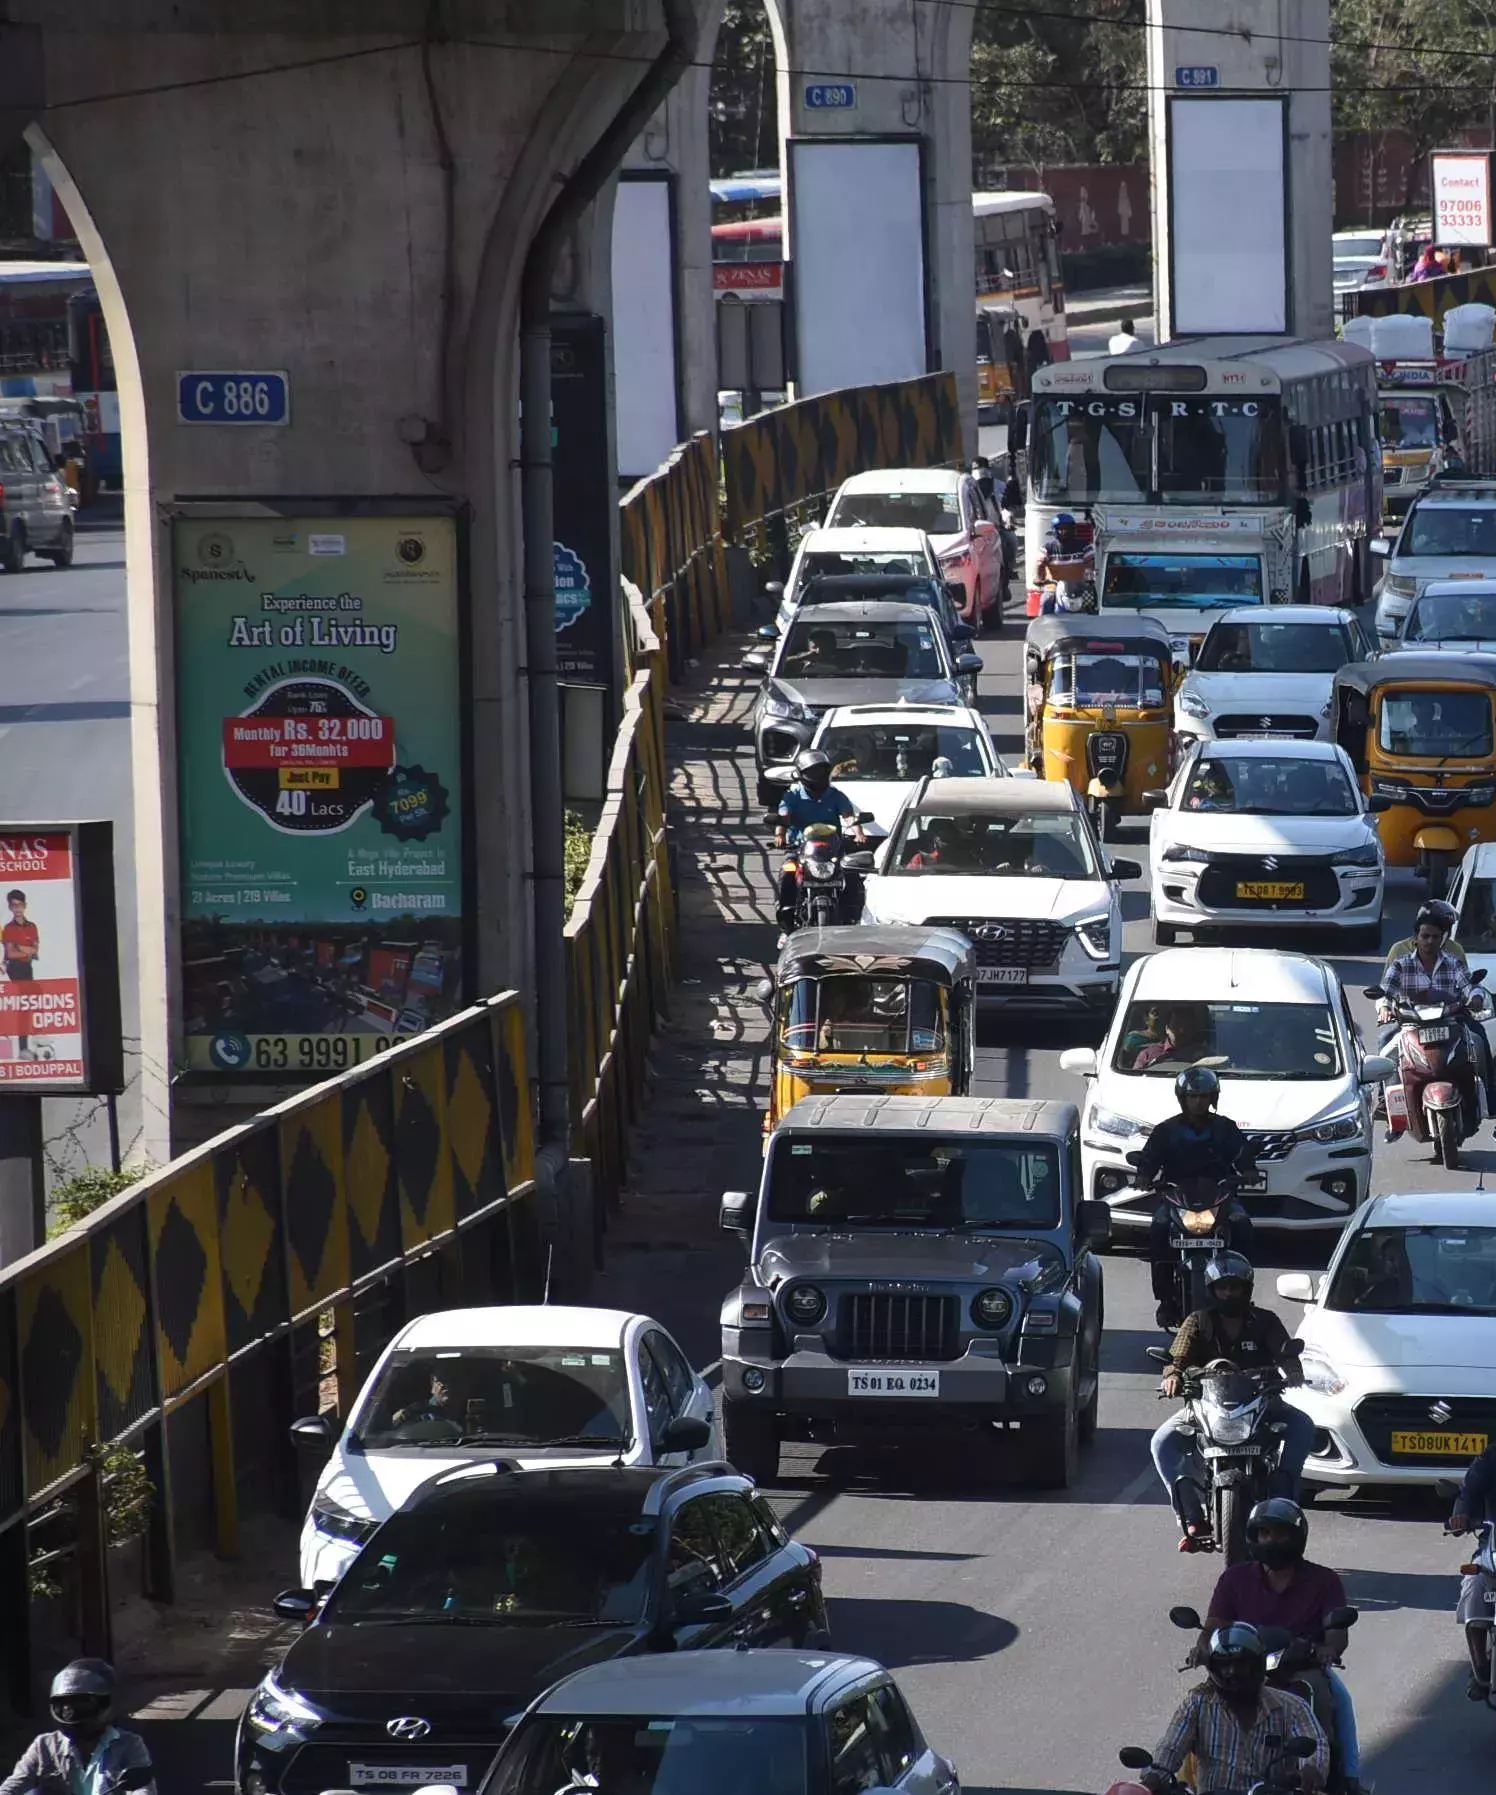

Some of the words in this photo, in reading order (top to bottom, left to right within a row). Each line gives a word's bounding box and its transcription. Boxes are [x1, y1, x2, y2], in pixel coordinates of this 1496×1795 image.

[812, 88, 821, 105] C
[1441, 176, 1479, 188] Contact
[1440, 199, 1481, 212] 97006
[1440, 215, 1481, 226] 33333
[196, 381, 214, 414] C
[223, 381, 269, 415] 886
[263, 595, 336, 612] Experience
[340, 594, 361, 610] the
[230, 617, 271, 646] Art
[280, 617, 304, 645] of
[311, 617, 397, 652] Living
[243, 661, 286, 698] RENTAL
[289, 659, 335, 675] INCOME
[338, 666, 371, 697] OFFER
[234, 727, 281, 742] Monthly
[284, 719, 313, 740] Rs.
[318, 719, 383, 741] 32,000
[270, 744, 288, 757] for
[312, 771, 331, 785] Pay
[311, 803, 344, 816] Lacs
[390, 791, 428, 814] 7099
[0, 861, 47, 872] SCHOOL
[348, 861, 376, 876] East
[378, 861, 445, 878] Hyderabad
[264, 890, 291, 903] Villas
[372, 893, 445, 909] Bacharam
[0, 994, 75, 1011] MISSIONS
[32, 1011, 76, 1028] OPEN
[255, 1038, 288, 1067] 63
[300, 1037, 362, 1067] 9991
[16, 1062, 80, 1076] BODUPPAL
[852, 1377, 868, 1390] TS
[871, 1377, 882, 1390] 01
[910, 1378, 935, 1390] 0234
[356, 1771, 376, 1779] TS
[378, 1771, 397, 1780] 08
[425, 1771, 461, 1780] 7226
